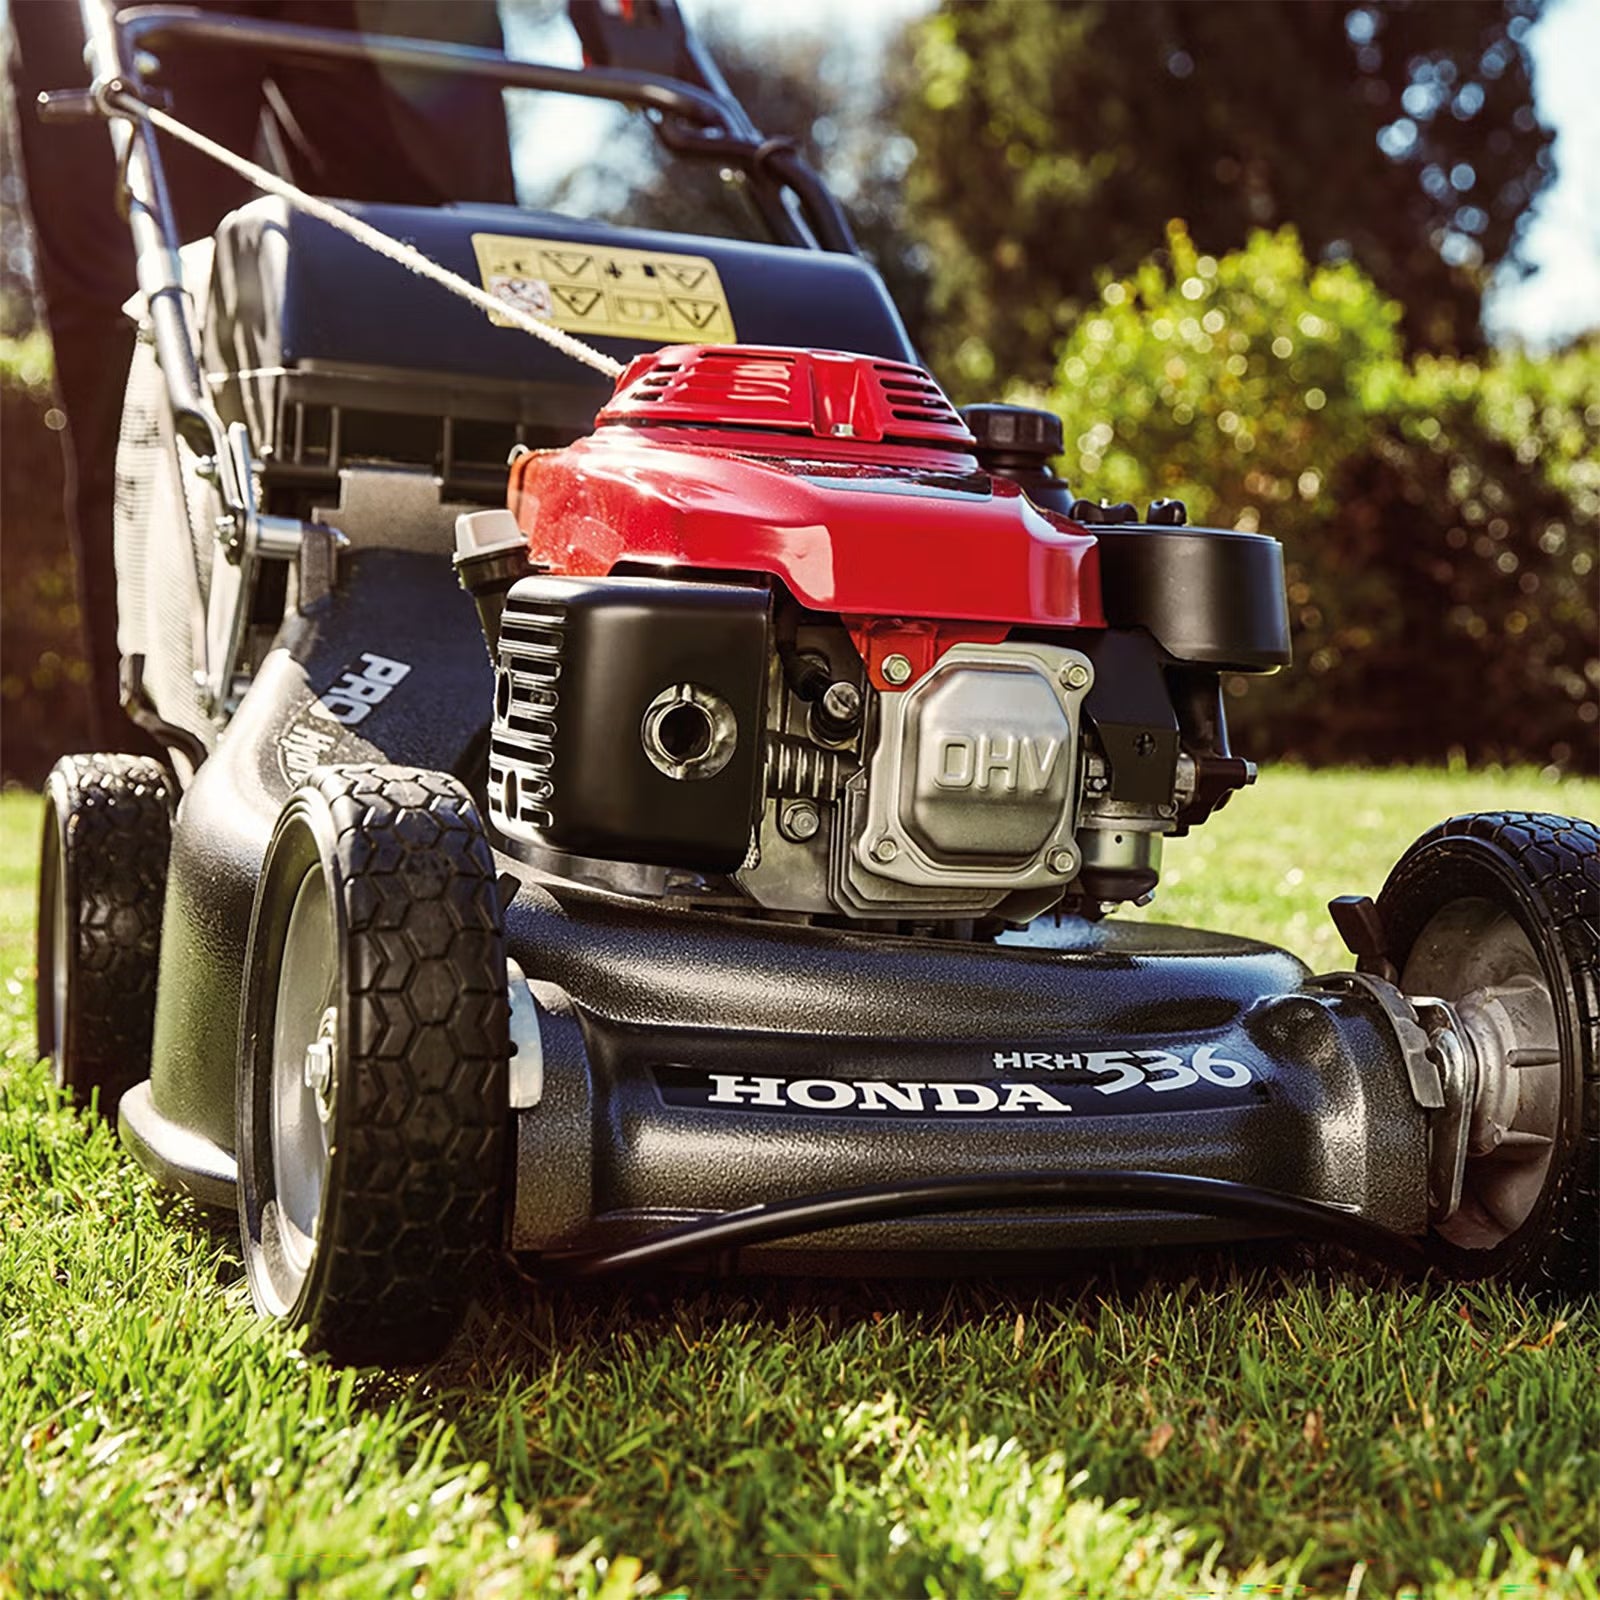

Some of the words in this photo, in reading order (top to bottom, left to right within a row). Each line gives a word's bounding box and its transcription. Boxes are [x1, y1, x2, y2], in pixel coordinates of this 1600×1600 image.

[309, 653, 411, 724] PRO
[936, 735, 1064, 794] OHV
[707, 1074, 1072, 1112] HONDA
